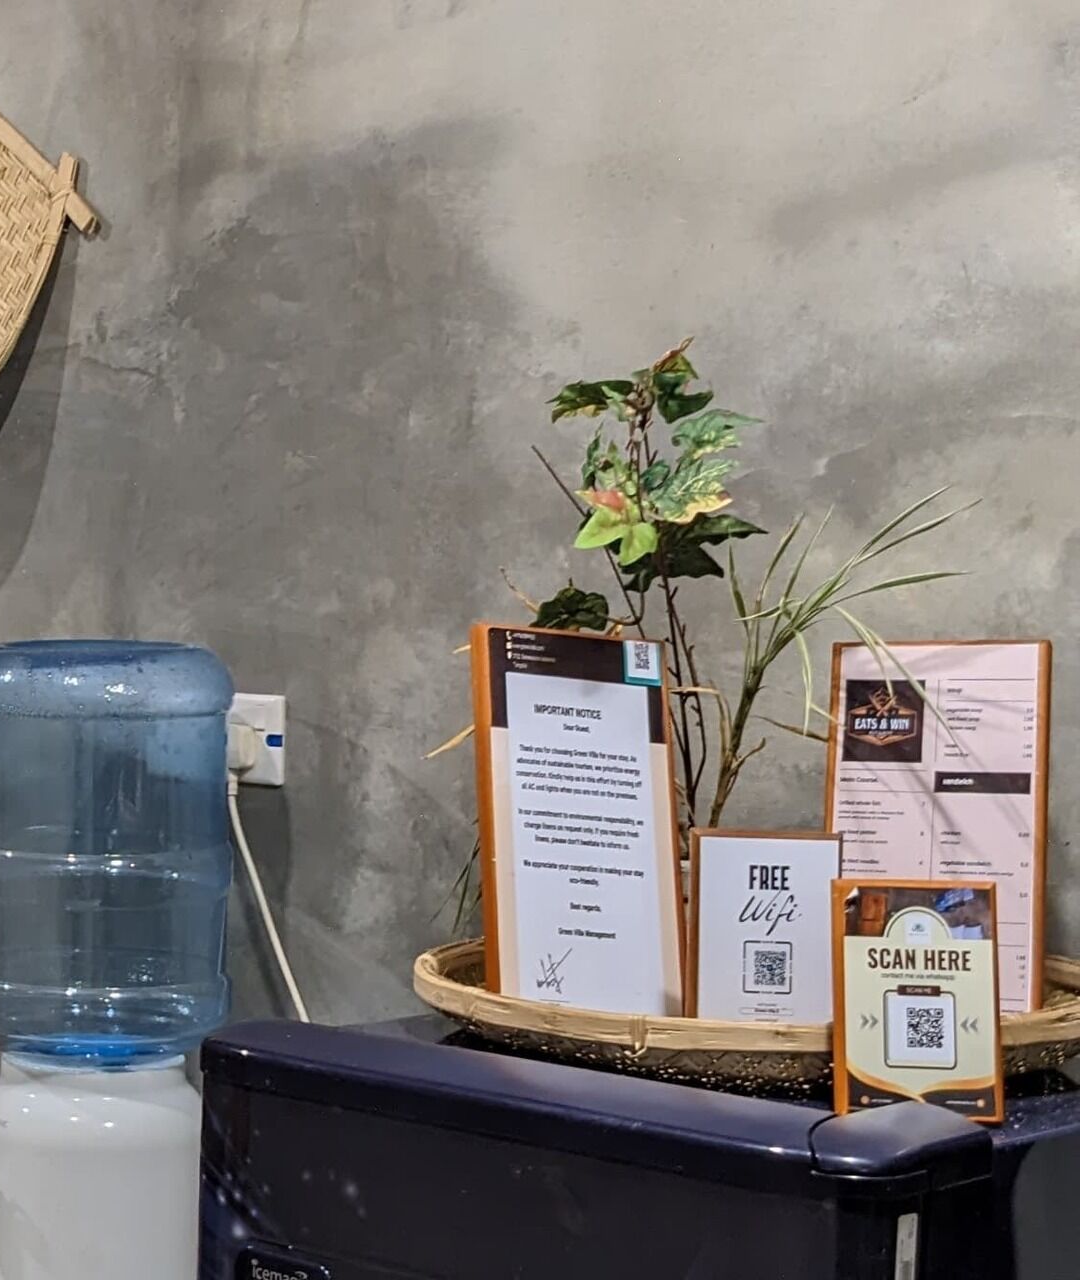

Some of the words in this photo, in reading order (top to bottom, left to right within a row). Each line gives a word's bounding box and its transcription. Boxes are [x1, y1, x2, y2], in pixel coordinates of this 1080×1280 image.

[533, 704, 574, 716] IMPORTANT
[575, 709, 602, 720] NOTICE
[854, 717, 878, 730] EATS
[889, 718, 910, 730] WIN
[749, 864, 790, 891] FREE
[738, 892, 802, 936] Wifi
[867, 948, 916, 970] SCAN
[923, 949, 971, 971] HERE
